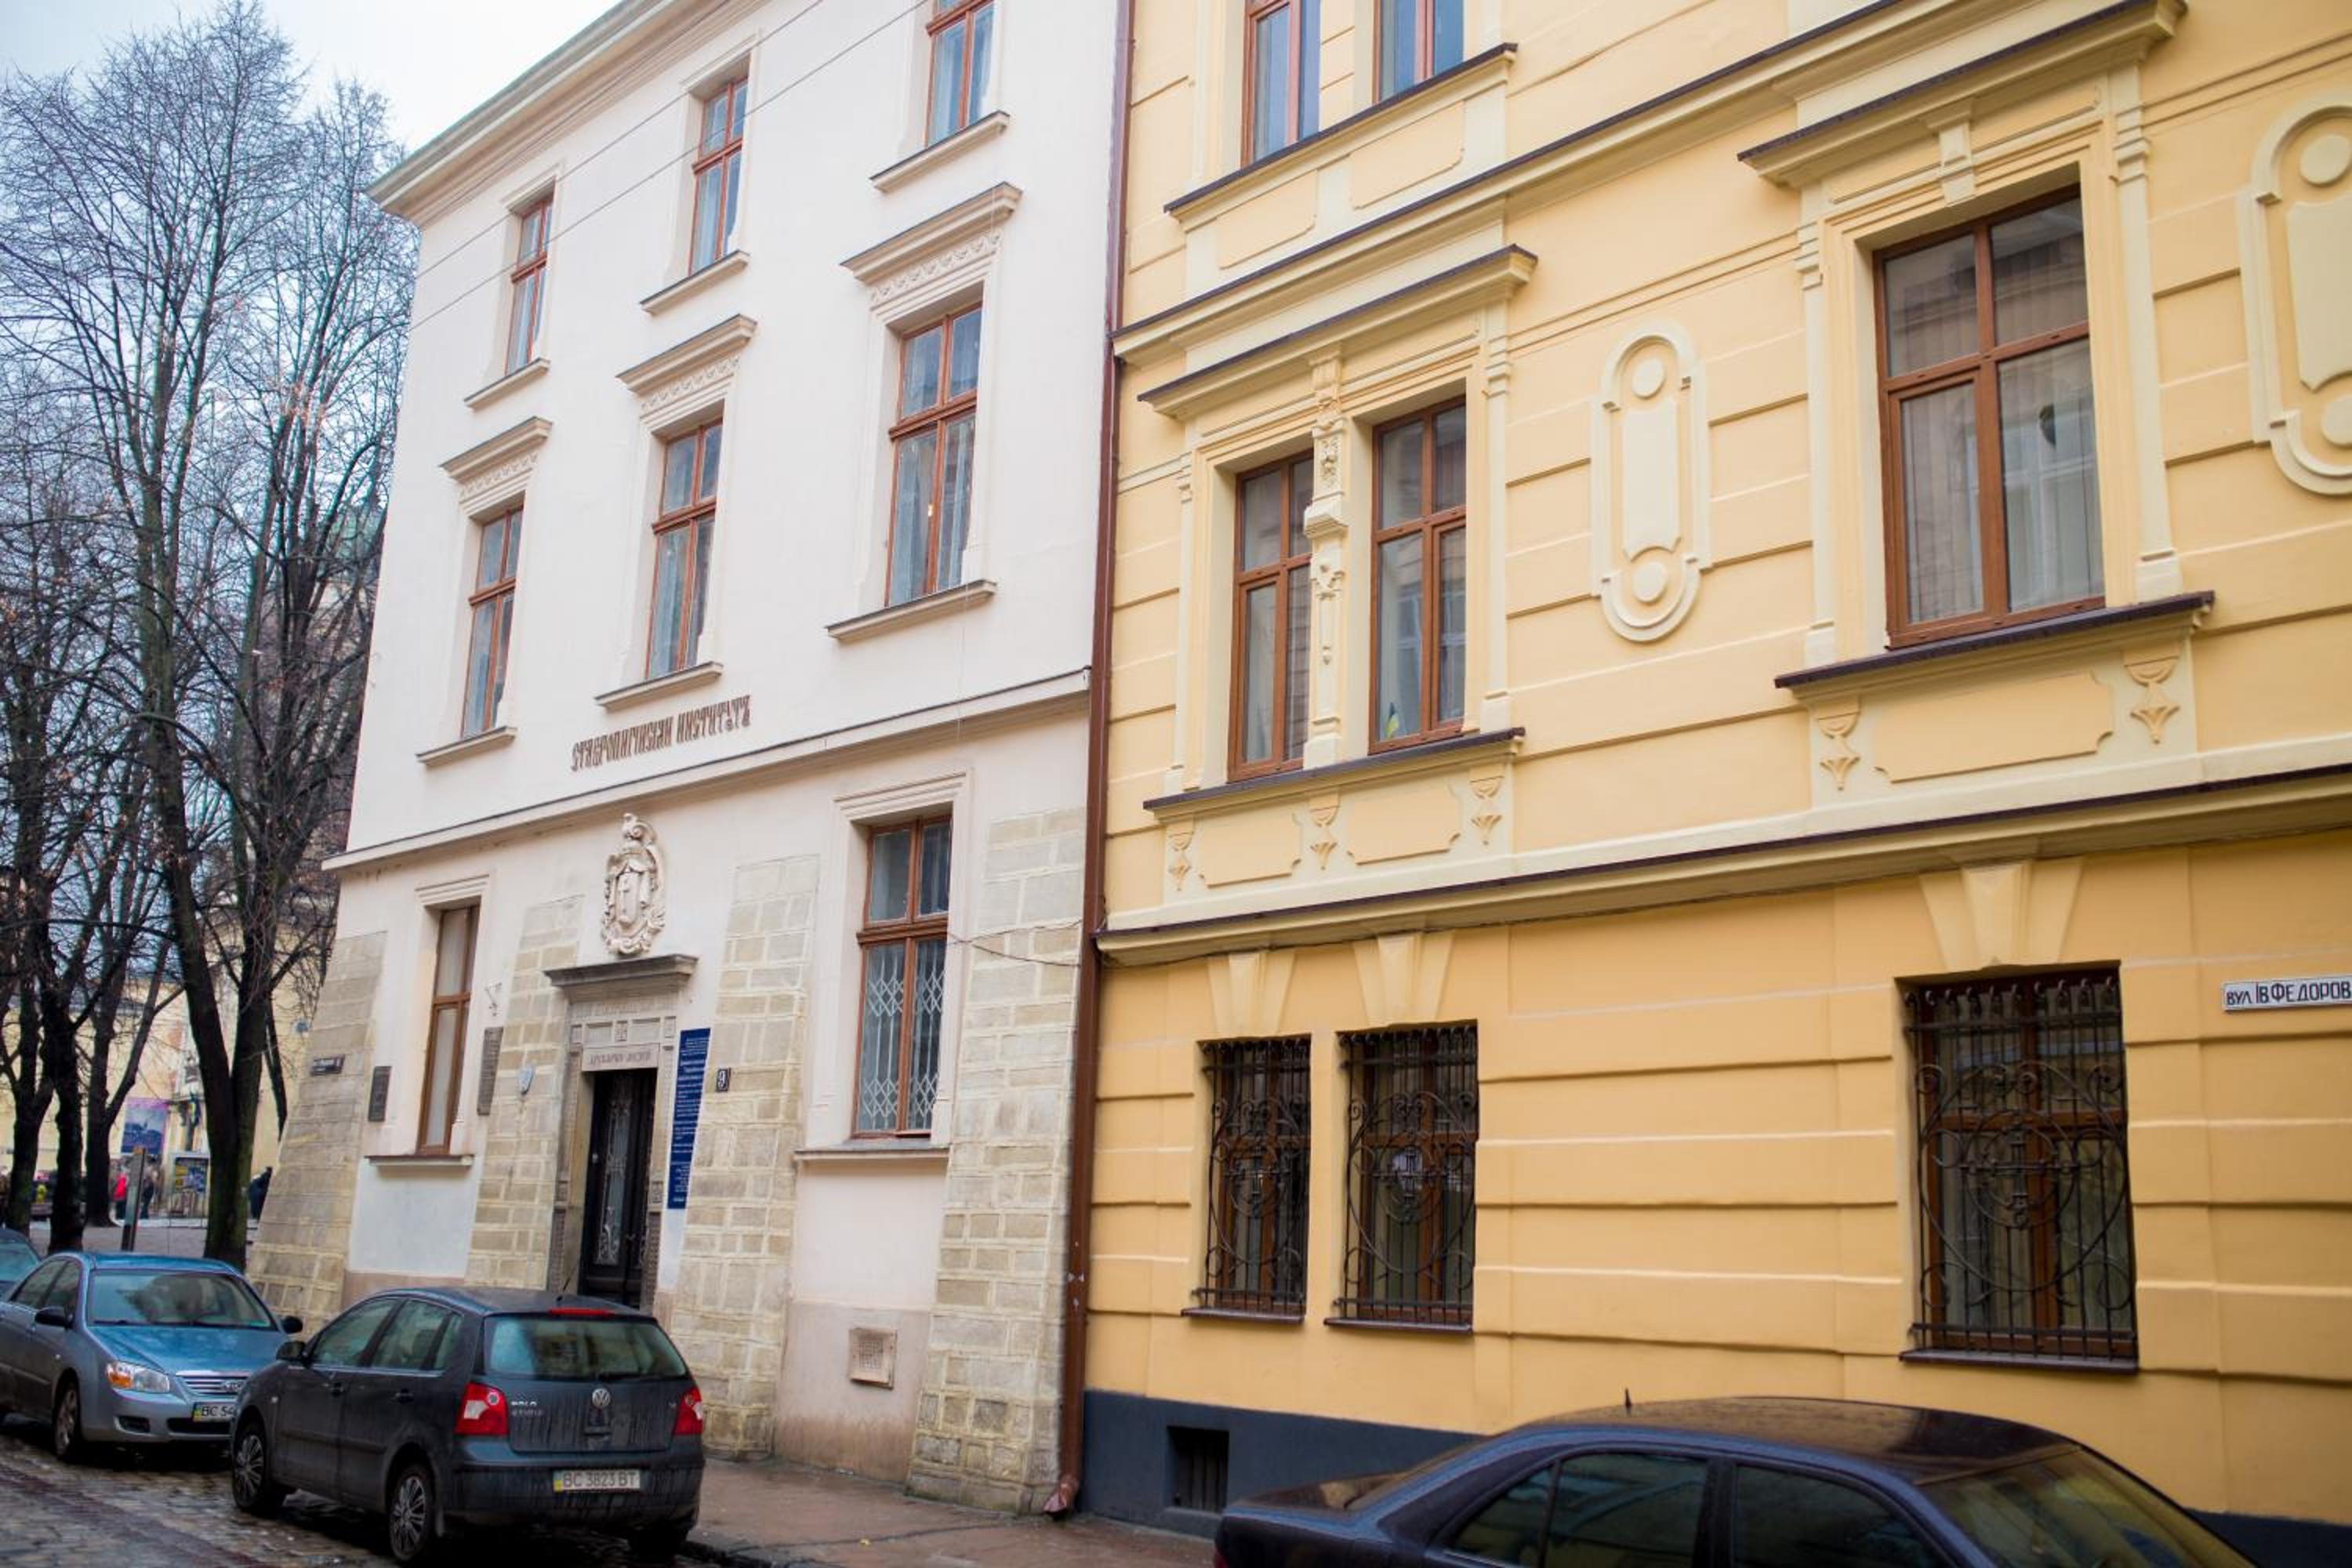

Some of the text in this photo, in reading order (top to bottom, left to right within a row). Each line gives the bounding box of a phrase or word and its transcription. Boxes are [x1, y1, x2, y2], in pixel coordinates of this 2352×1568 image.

[717, 1069, 728, 1091] 9
[563, 1468, 636, 1487] BC 3823 BT
